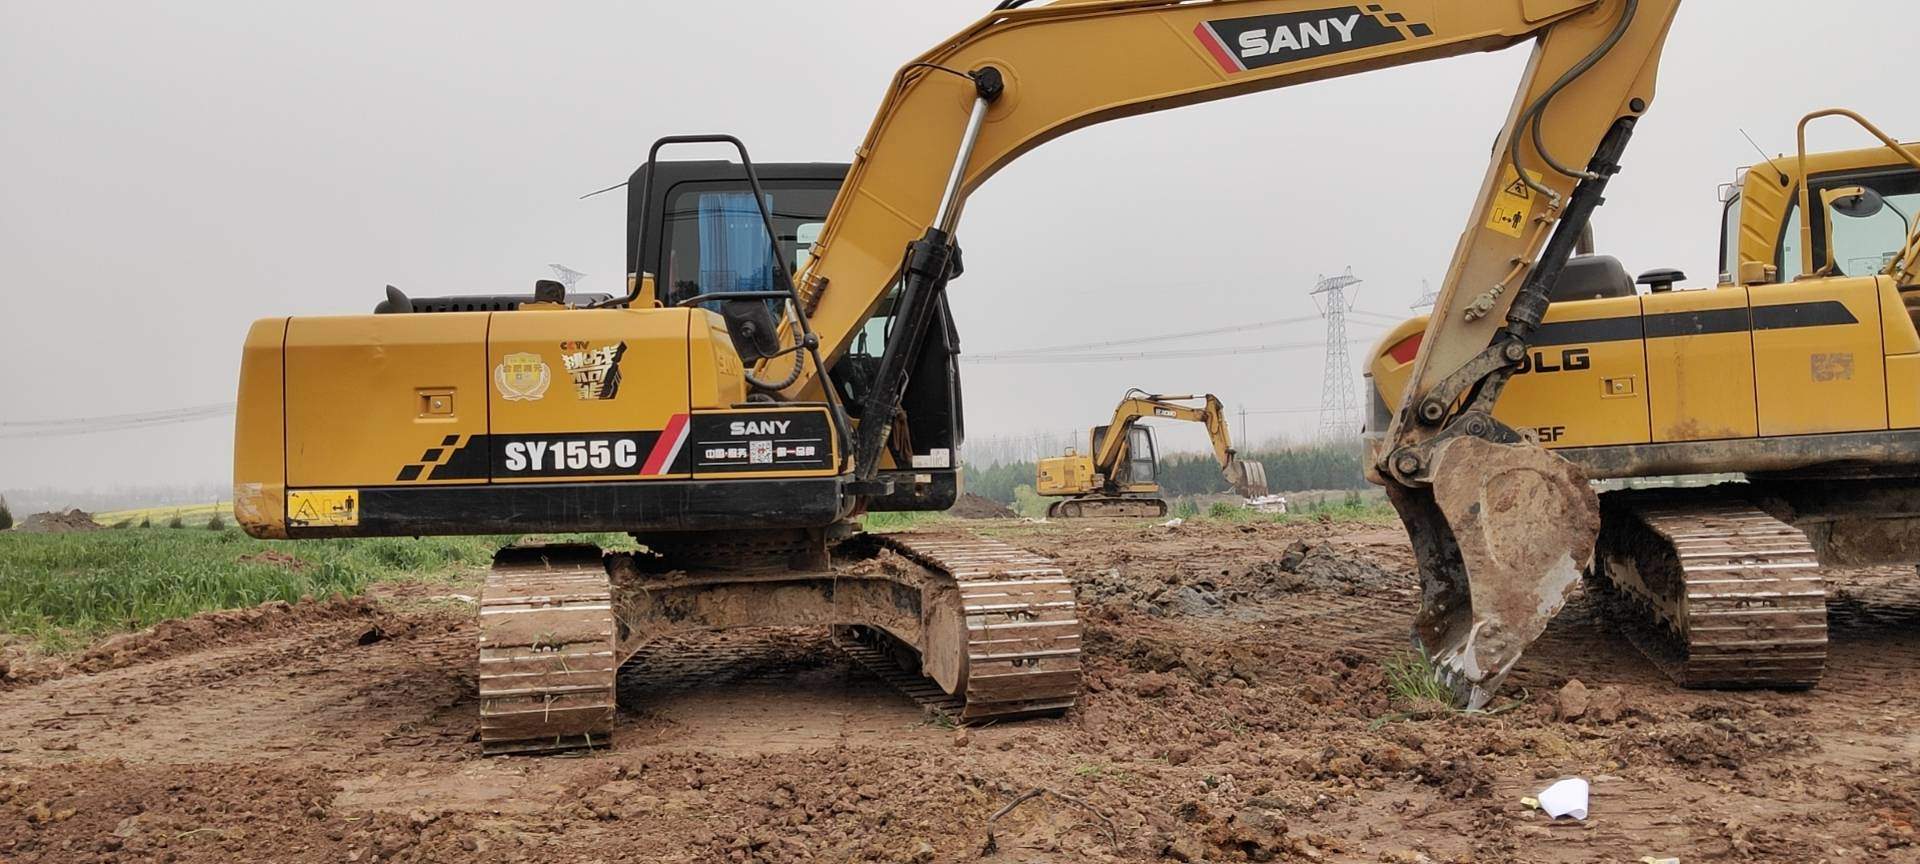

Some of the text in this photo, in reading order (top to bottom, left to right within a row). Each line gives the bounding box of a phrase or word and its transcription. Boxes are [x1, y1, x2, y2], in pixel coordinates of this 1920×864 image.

[1238, 14, 1360, 58] SANY
[560, 341, 589, 350] CCTV
[729, 420, 791, 436] SANY
[505, 438, 637, 472] SY155C
